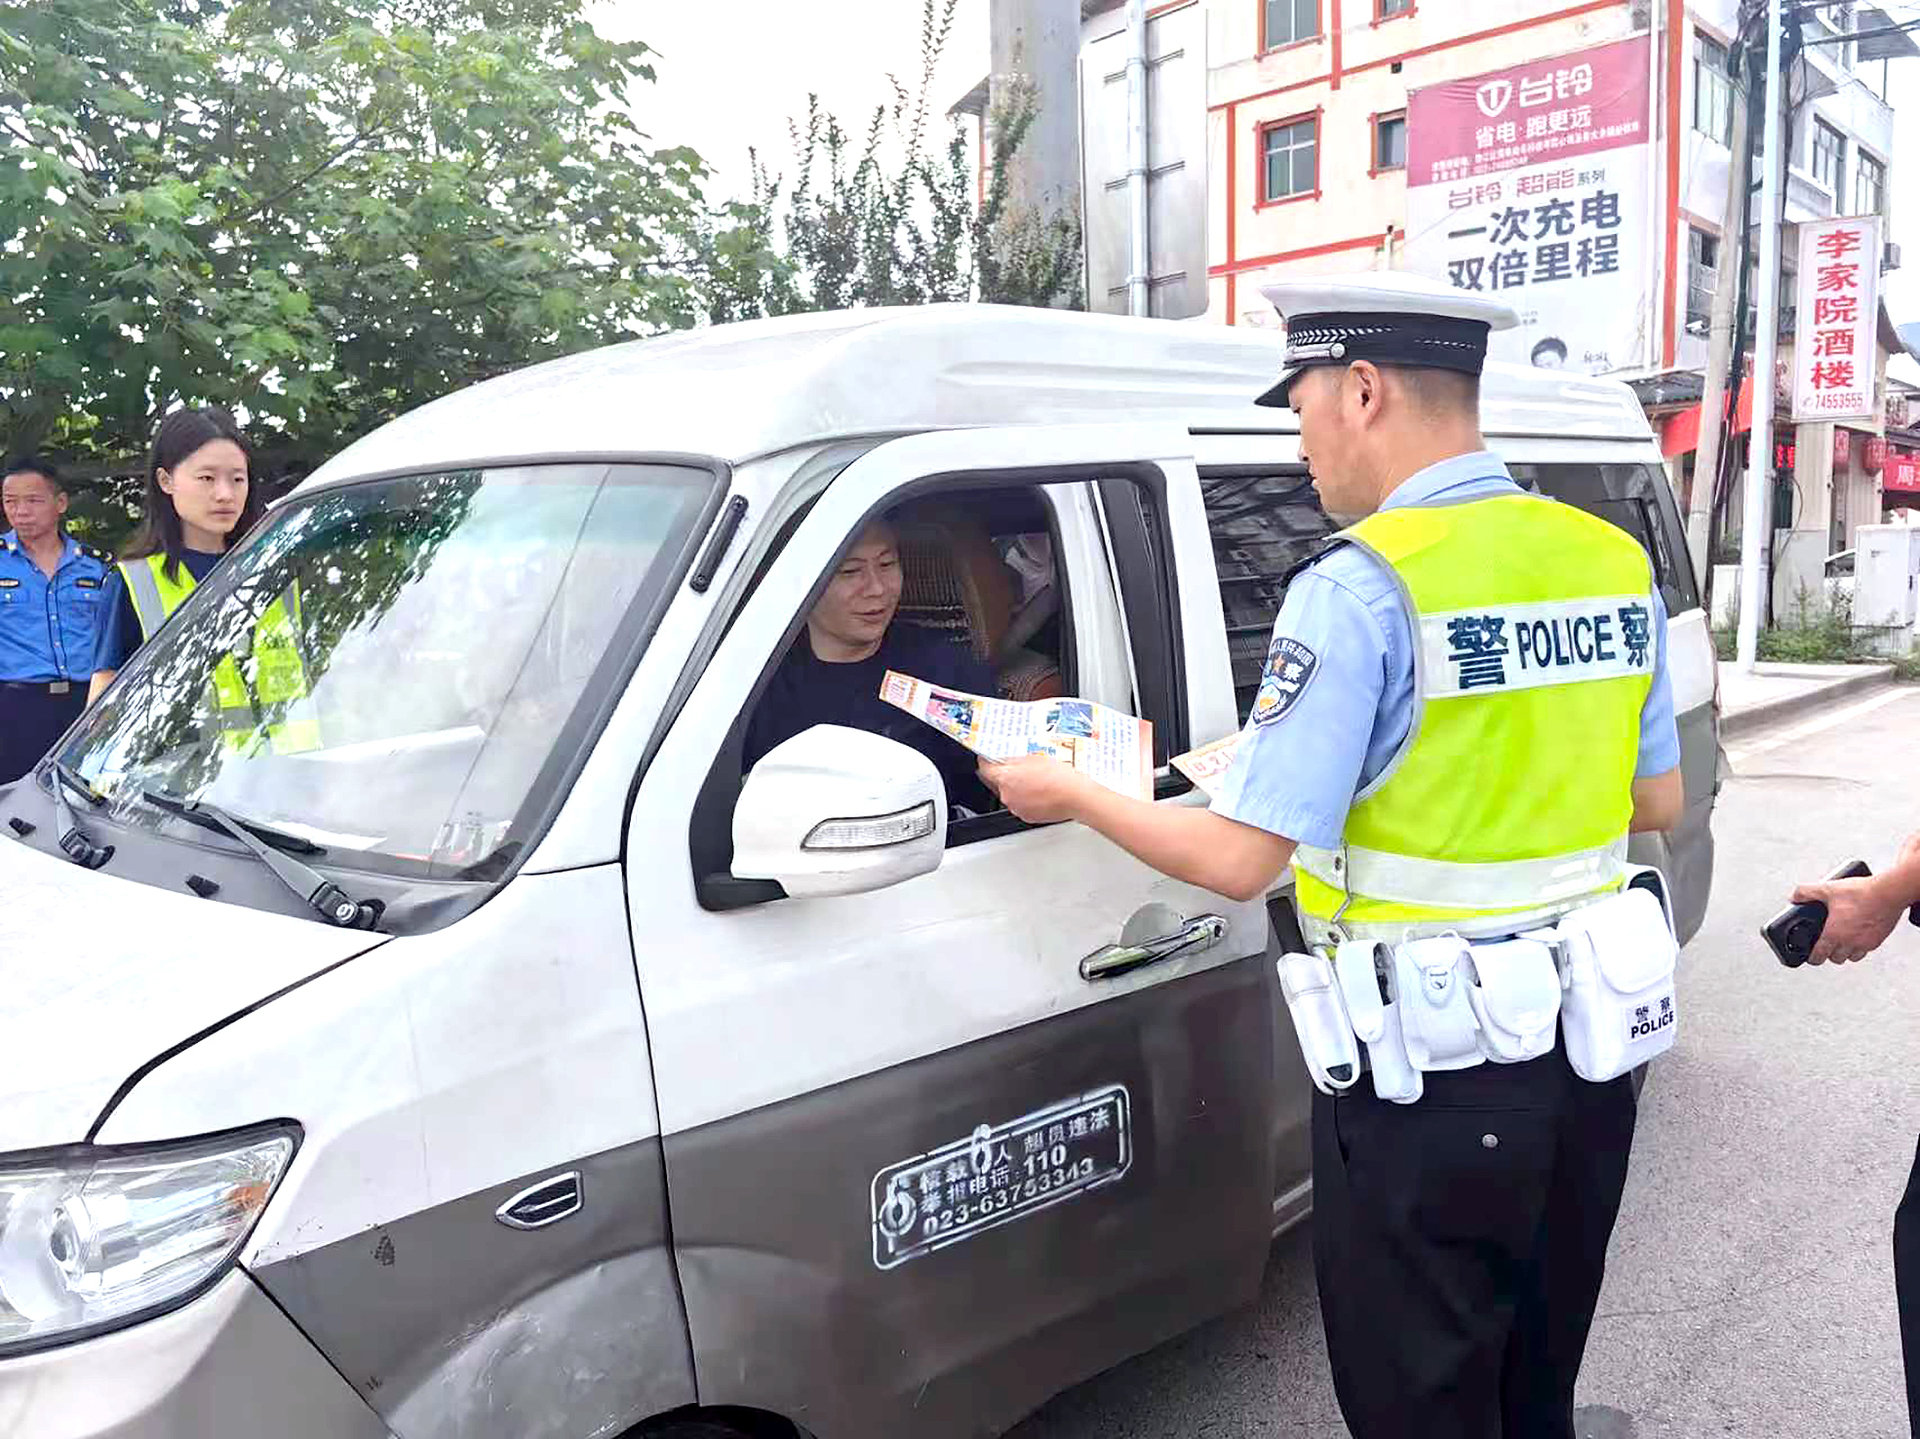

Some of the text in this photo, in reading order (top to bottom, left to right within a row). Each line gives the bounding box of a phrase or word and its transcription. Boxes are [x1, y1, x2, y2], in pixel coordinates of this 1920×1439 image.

[1519, 63, 1593, 108] 台铃
[1448, 180, 1502, 209] 台铃
[1448, 189, 1622, 246] 一次充电
[1448, 233, 1619, 291] 双倍里程
[1809, 229, 1862, 389] 李家院酒楼
[1815, 392, 1863, 409] 74553555
[1447, 602, 1649, 689] 警 POLICE 察
[1631, 1011, 1674, 1038] POLICE
[1024, 1144, 1067, 1176] 110
[922, 1158, 1094, 1236] 023-63753343
